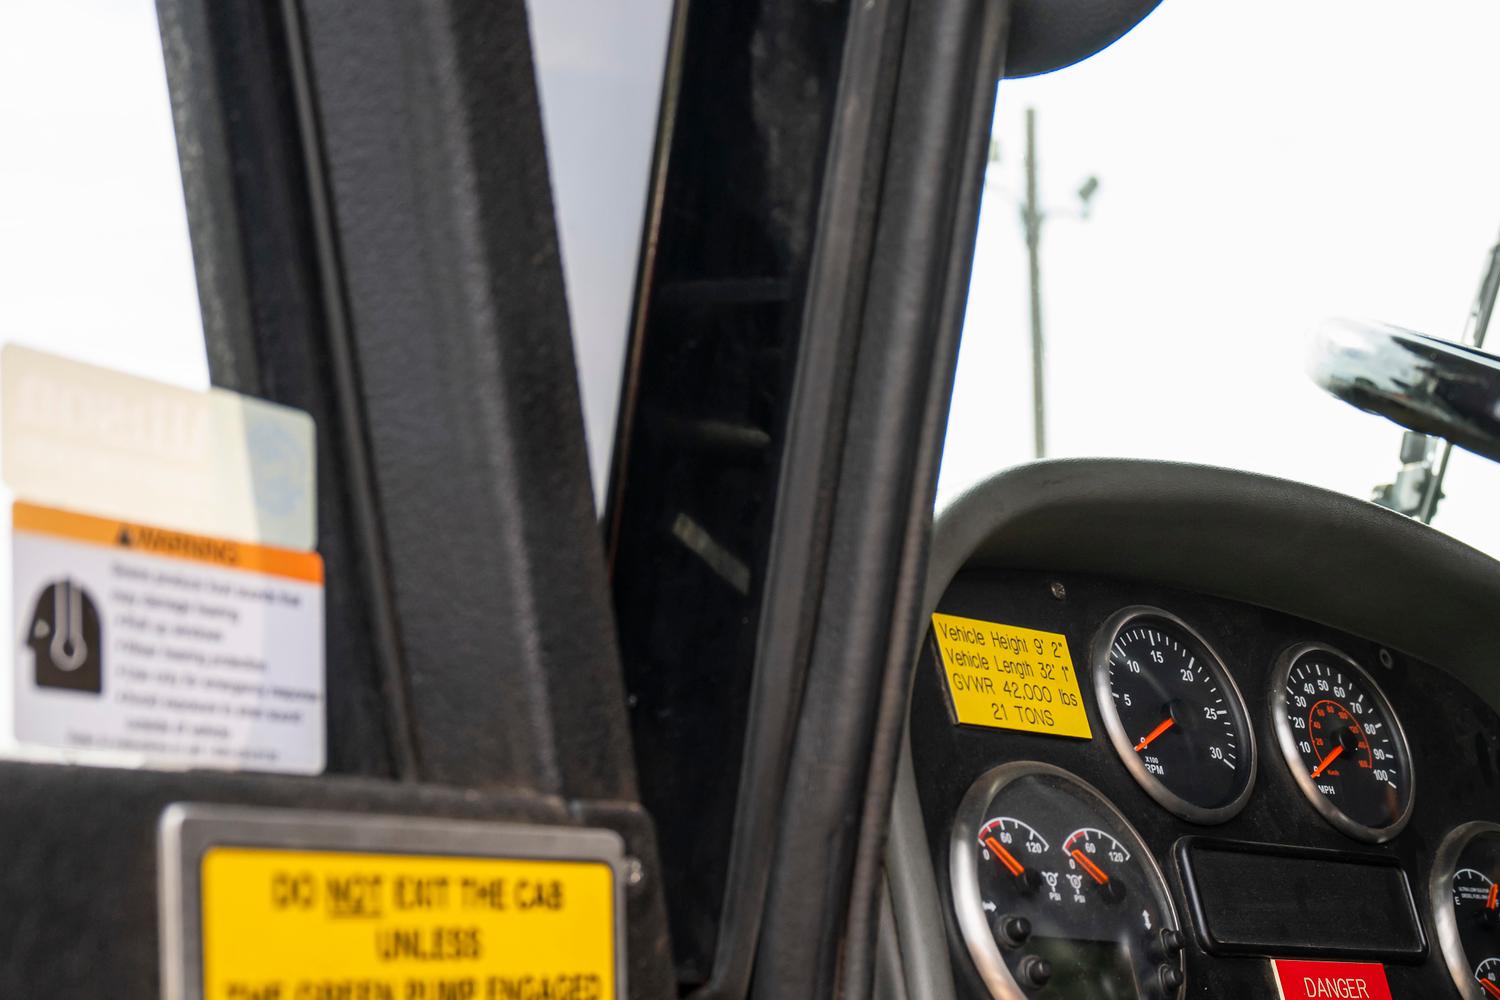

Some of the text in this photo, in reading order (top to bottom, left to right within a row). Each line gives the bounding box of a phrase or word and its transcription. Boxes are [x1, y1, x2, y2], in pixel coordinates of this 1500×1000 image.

[938, 622, 1062, 658] Vehicle Height 9' 2"
[1150, 650, 1164, 664] 15
[946, 648, 989, 670] Vehicle
[994, 656, 1034, 679] Length
[1038, 662, 1056, 680] 32'
[1126, 660, 1140, 674] 10
[1180, 669, 1194, 682] 20
[952, 673, 1078, 706] GVWR 42,000 lbs
[1304, 683, 1315, 695] 40
[1318, 680, 1329, 692] 50
[1334, 686, 1346, 698] 60
[1124, 694, 1132, 706] 5
[1295, 696, 1307, 708] 30
[1204, 707, 1218, 720] 25
[1350, 702, 1362, 714] 70
[992, 703, 1054, 726] 21 TONS
[1293, 717, 1305, 729] 20
[1364, 723, 1376, 735] 80
[1210, 747, 1222, 760] 30
[1300, 742, 1311, 754] 10
[1374, 748, 1385, 760] 90
[1373, 770, 1388, 782] 100
[1318, 784, 1336, 794] MPH
[1000, 832, 1012, 844] 60
[1026, 842, 1042, 854] 120
[982, 849, 990, 860] 0
[1108, 852, 1124, 862] 120
[1069, 858, 1076, 869] 0
[272, 871, 564, 913] DO NOT EXIT THE CAB
[375, 926, 483, 962] UNLESS
[1304, 977, 1370, 999] DANGER
